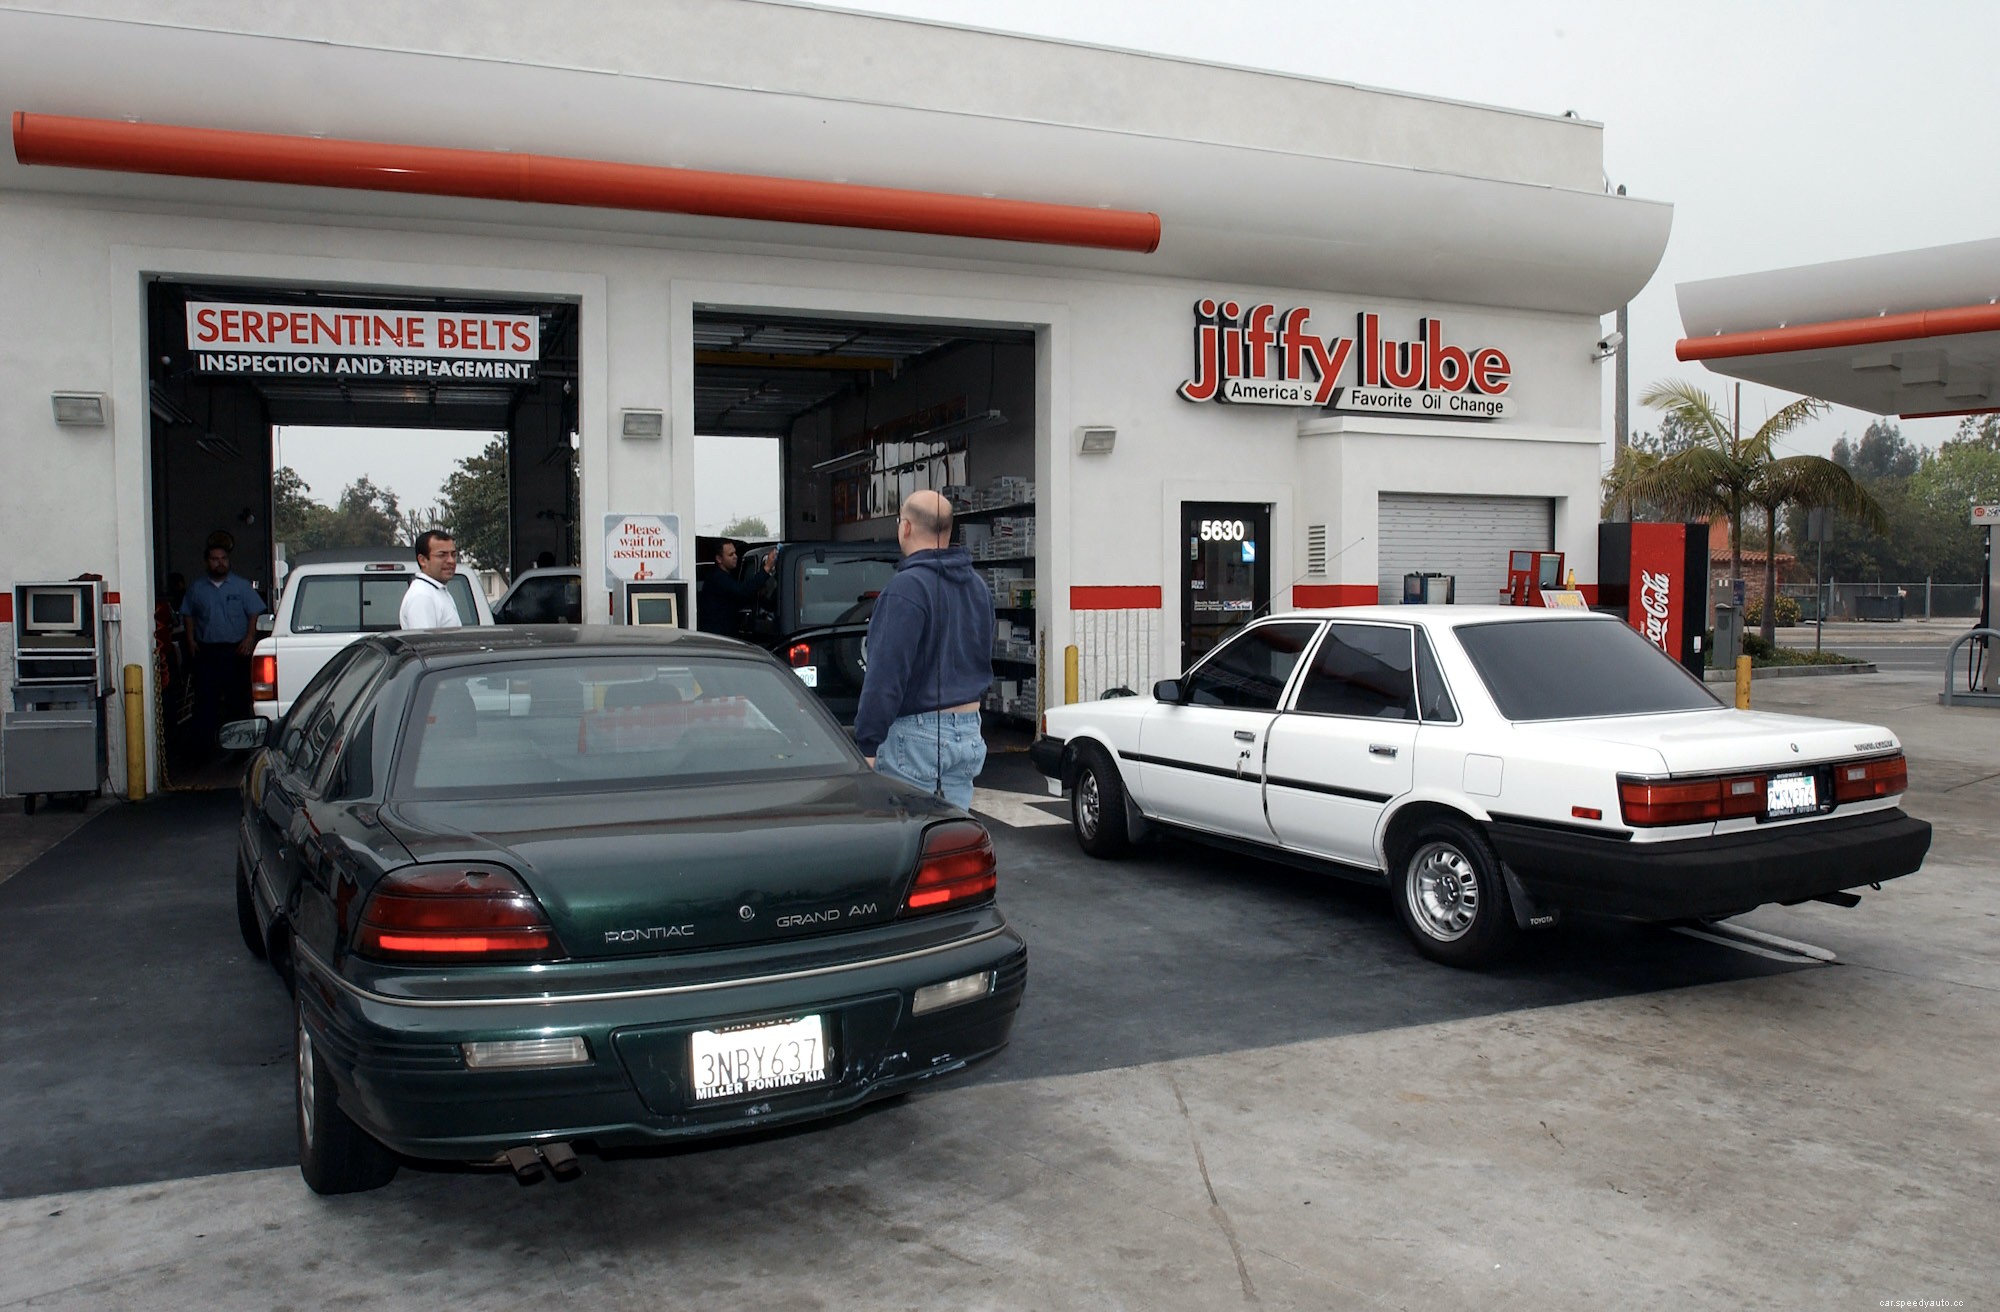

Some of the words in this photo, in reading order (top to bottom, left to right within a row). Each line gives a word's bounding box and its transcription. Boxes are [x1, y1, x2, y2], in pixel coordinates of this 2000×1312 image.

[197, 308, 425, 347] SERPENTINE
[437, 318, 532, 352] BELTS
[199, 353, 329, 374] INSPECTION
[335, 357, 384, 375] AND
[1180, 298, 1354, 405] jiffy
[1361, 311, 1512, 396] lube
[1231, 381, 1312, 402] America's
[1351, 390, 1412, 408] Favorite
[1422, 393, 1441, 410] Oil
[1449, 395, 1504, 416] Change
[619, 535, 645, 547] wait
[648, 535, 666, 547] for
[624, 523, 661, 535] Please
[1200, 520, 1245, 541] 5630
[613, 547, 672, 558] assistance
[604, 923, 695, 944] PONTIAC
[776, 909, 841, 928] GRAND
[848, 902, 878, 917] AM
[1530, 916, 1553, 925] TOYOTA
[701, 1038, 817, 1086] 3NBY637
[695, 1081, 743, 1100] MILLER
[805, 1069, 826, 1083] KIA
